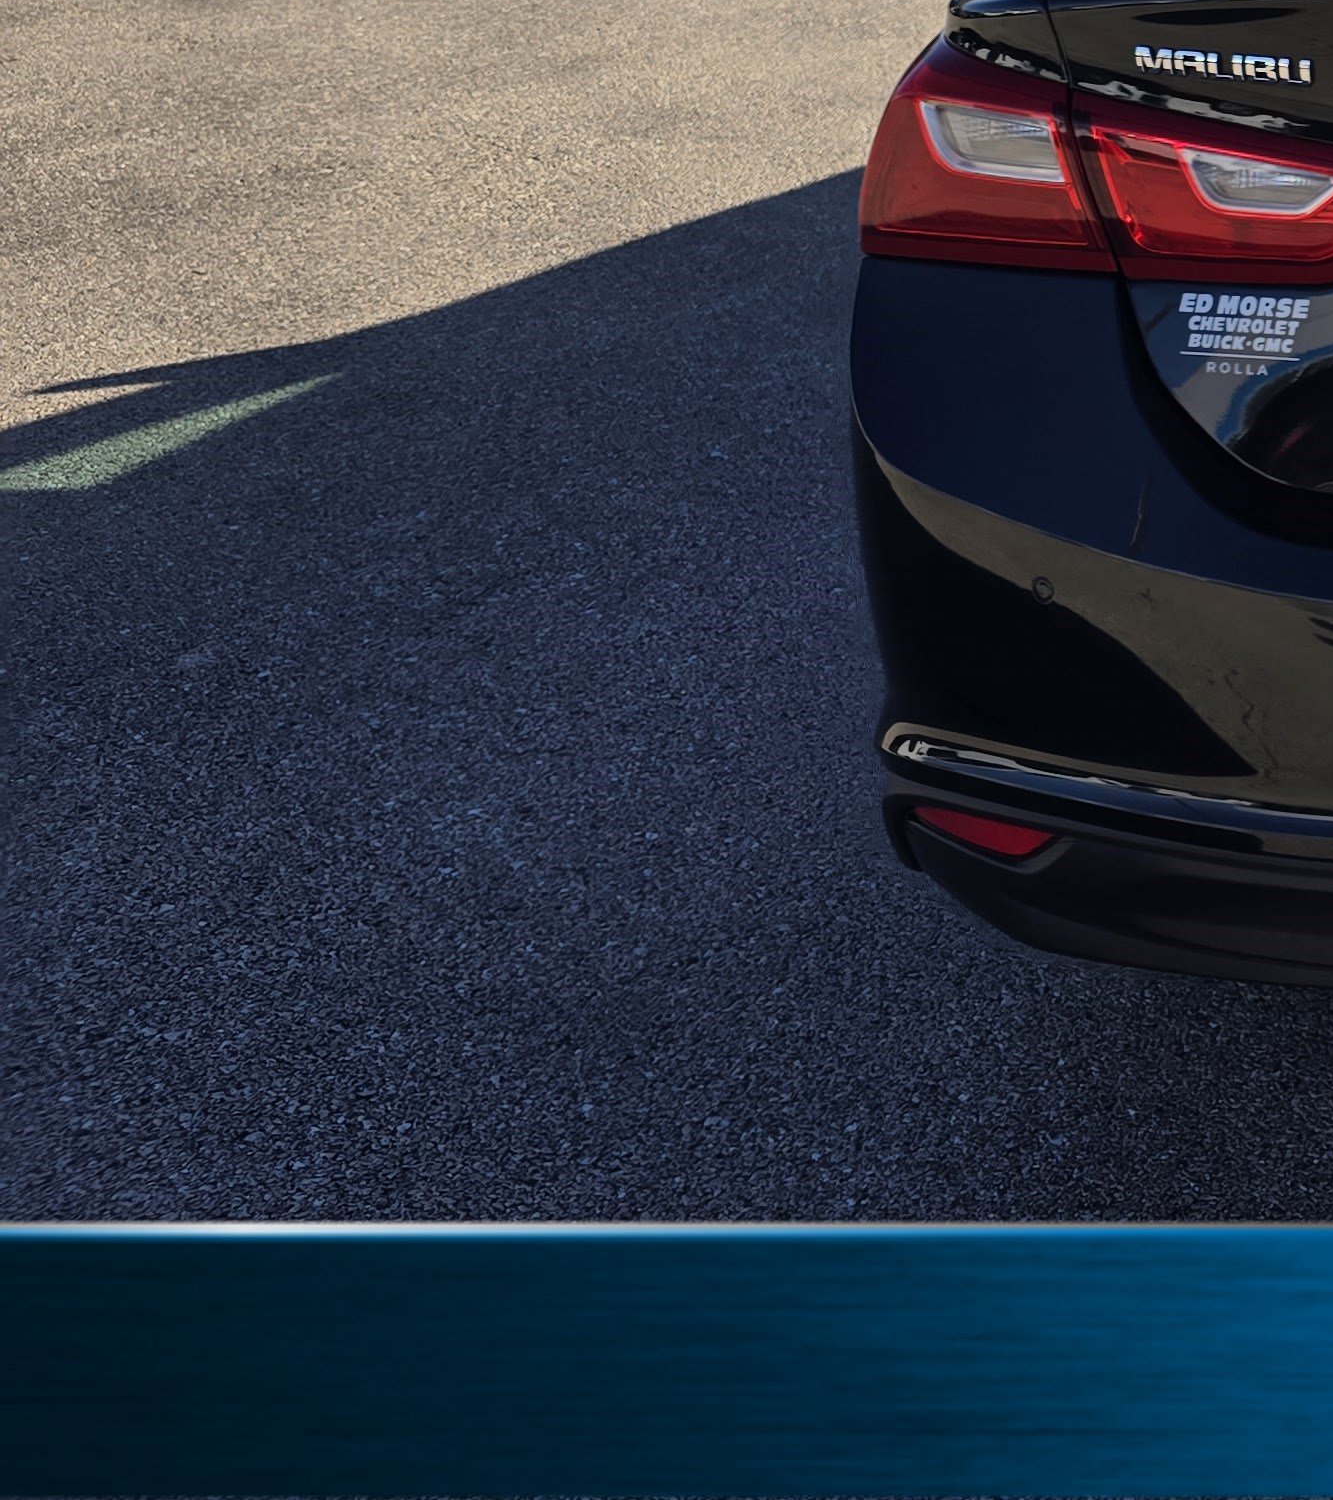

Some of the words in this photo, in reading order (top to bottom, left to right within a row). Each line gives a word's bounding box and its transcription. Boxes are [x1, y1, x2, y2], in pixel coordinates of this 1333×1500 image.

[1134, 46, 1312, 84] MALIBU
[1179, 293, 1213, 313] ED
[1216, 295, 1311, 319] MORSE
[1188, 315, 1300, 336] CHEVROLET
[1205, 361, 1268, 376] ROLLA
